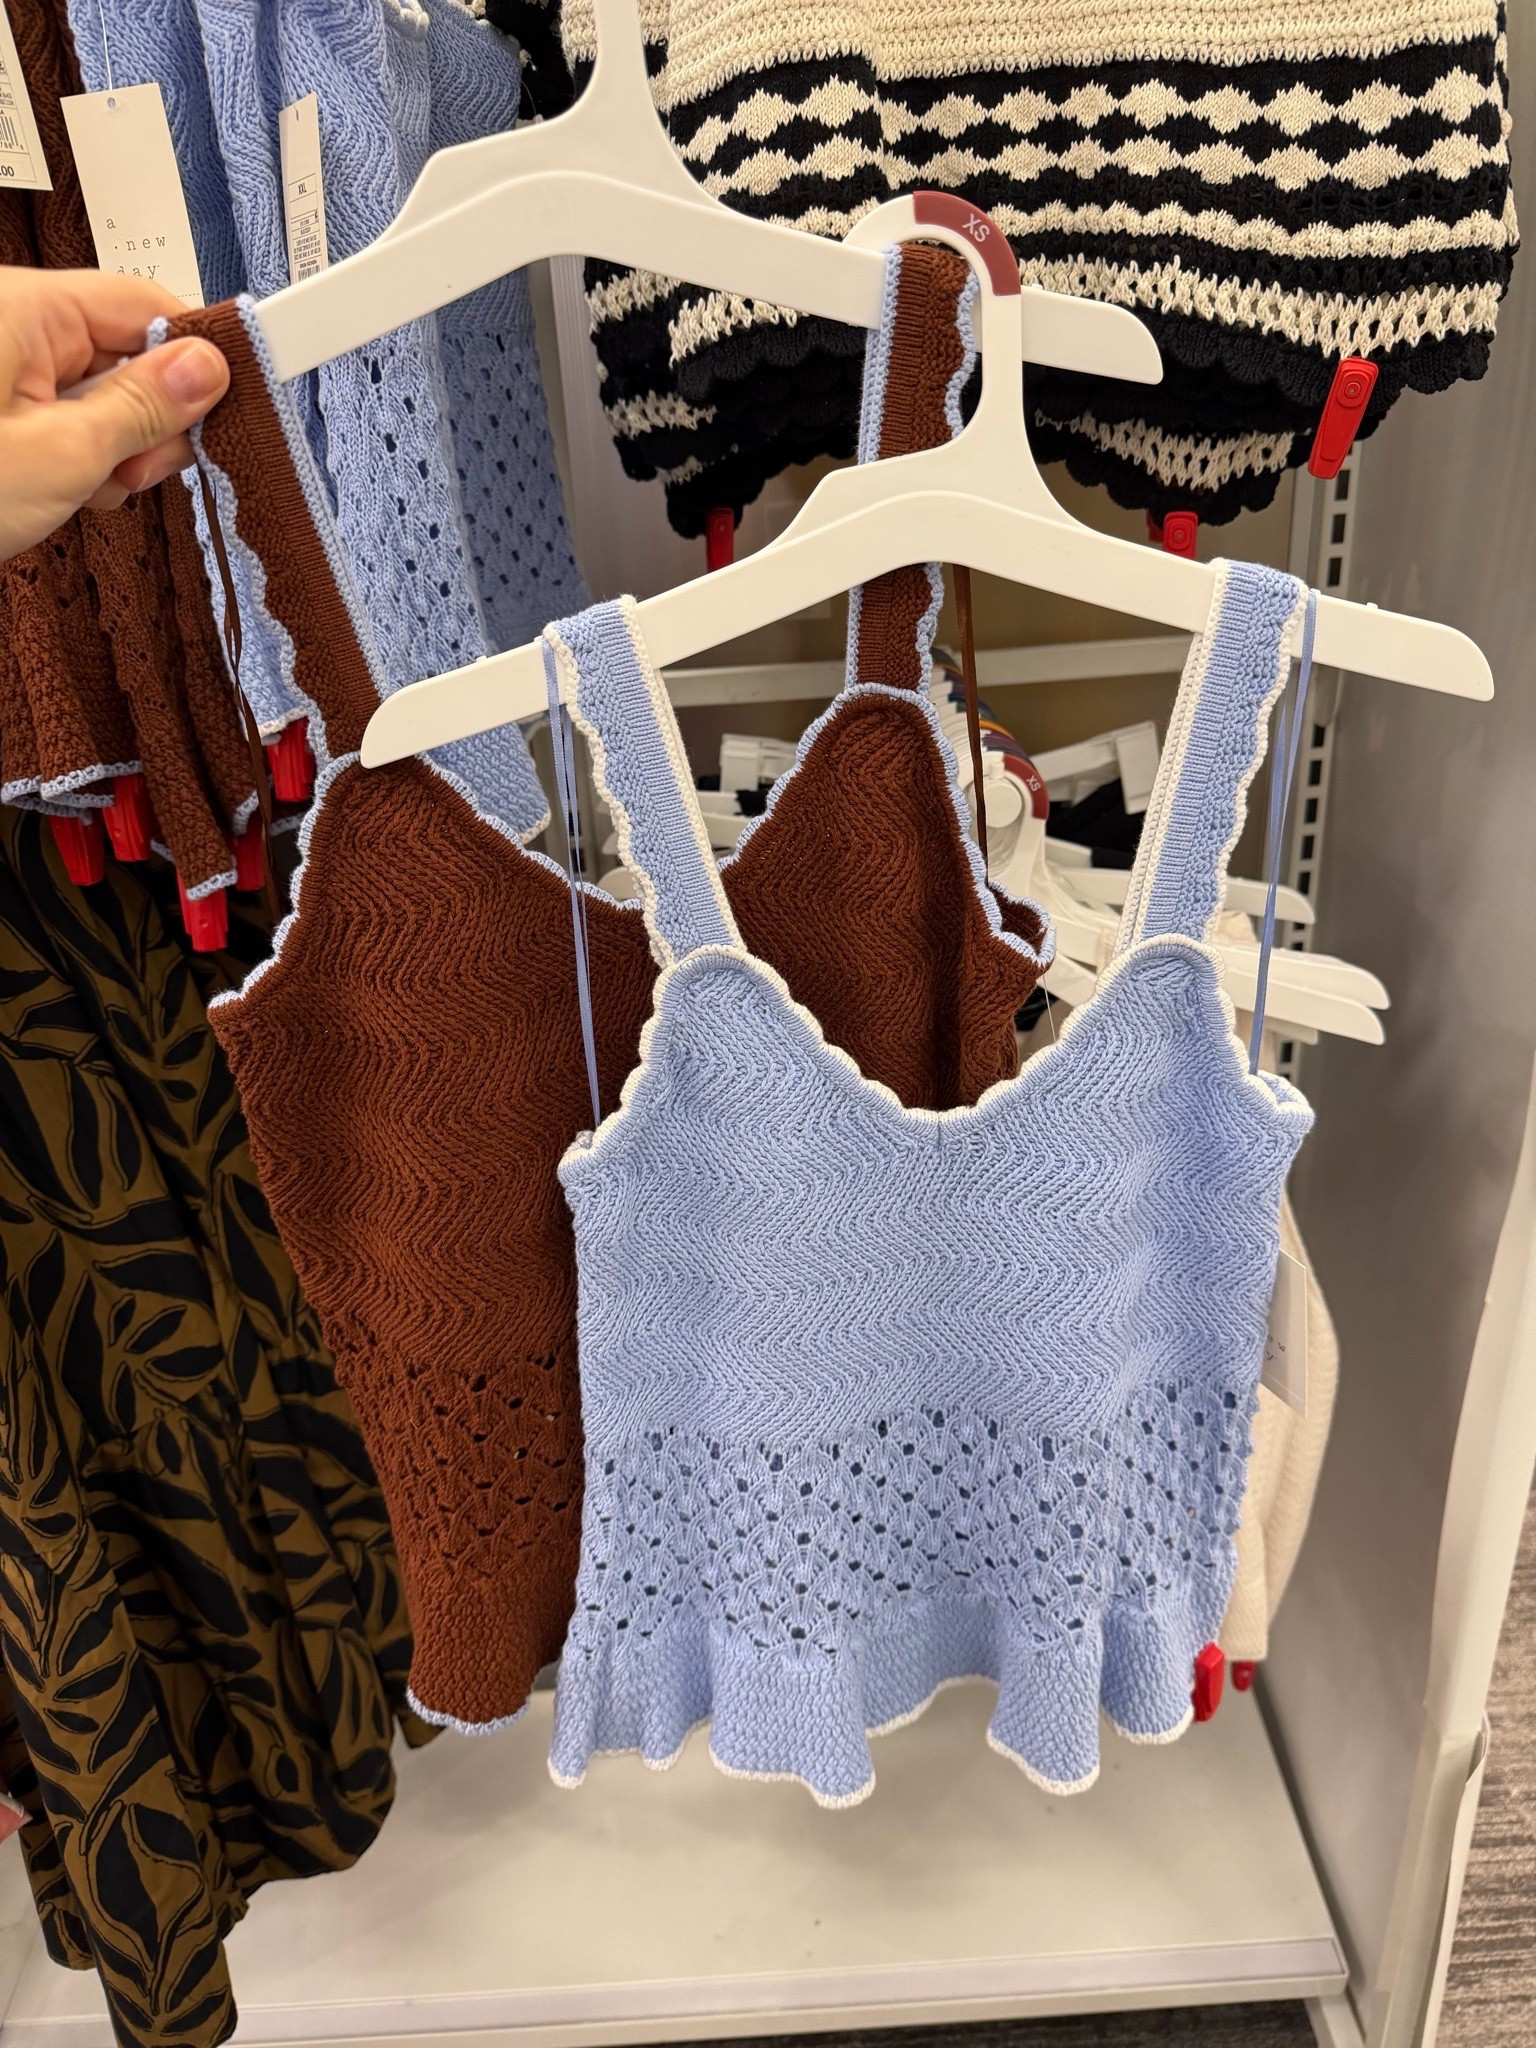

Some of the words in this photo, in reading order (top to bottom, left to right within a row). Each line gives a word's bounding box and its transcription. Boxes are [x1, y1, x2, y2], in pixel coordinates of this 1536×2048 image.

[106, 218, 117, 230] a
[961, 213, 991, 243] XS
[1026, 775, 1042, 793] XS
